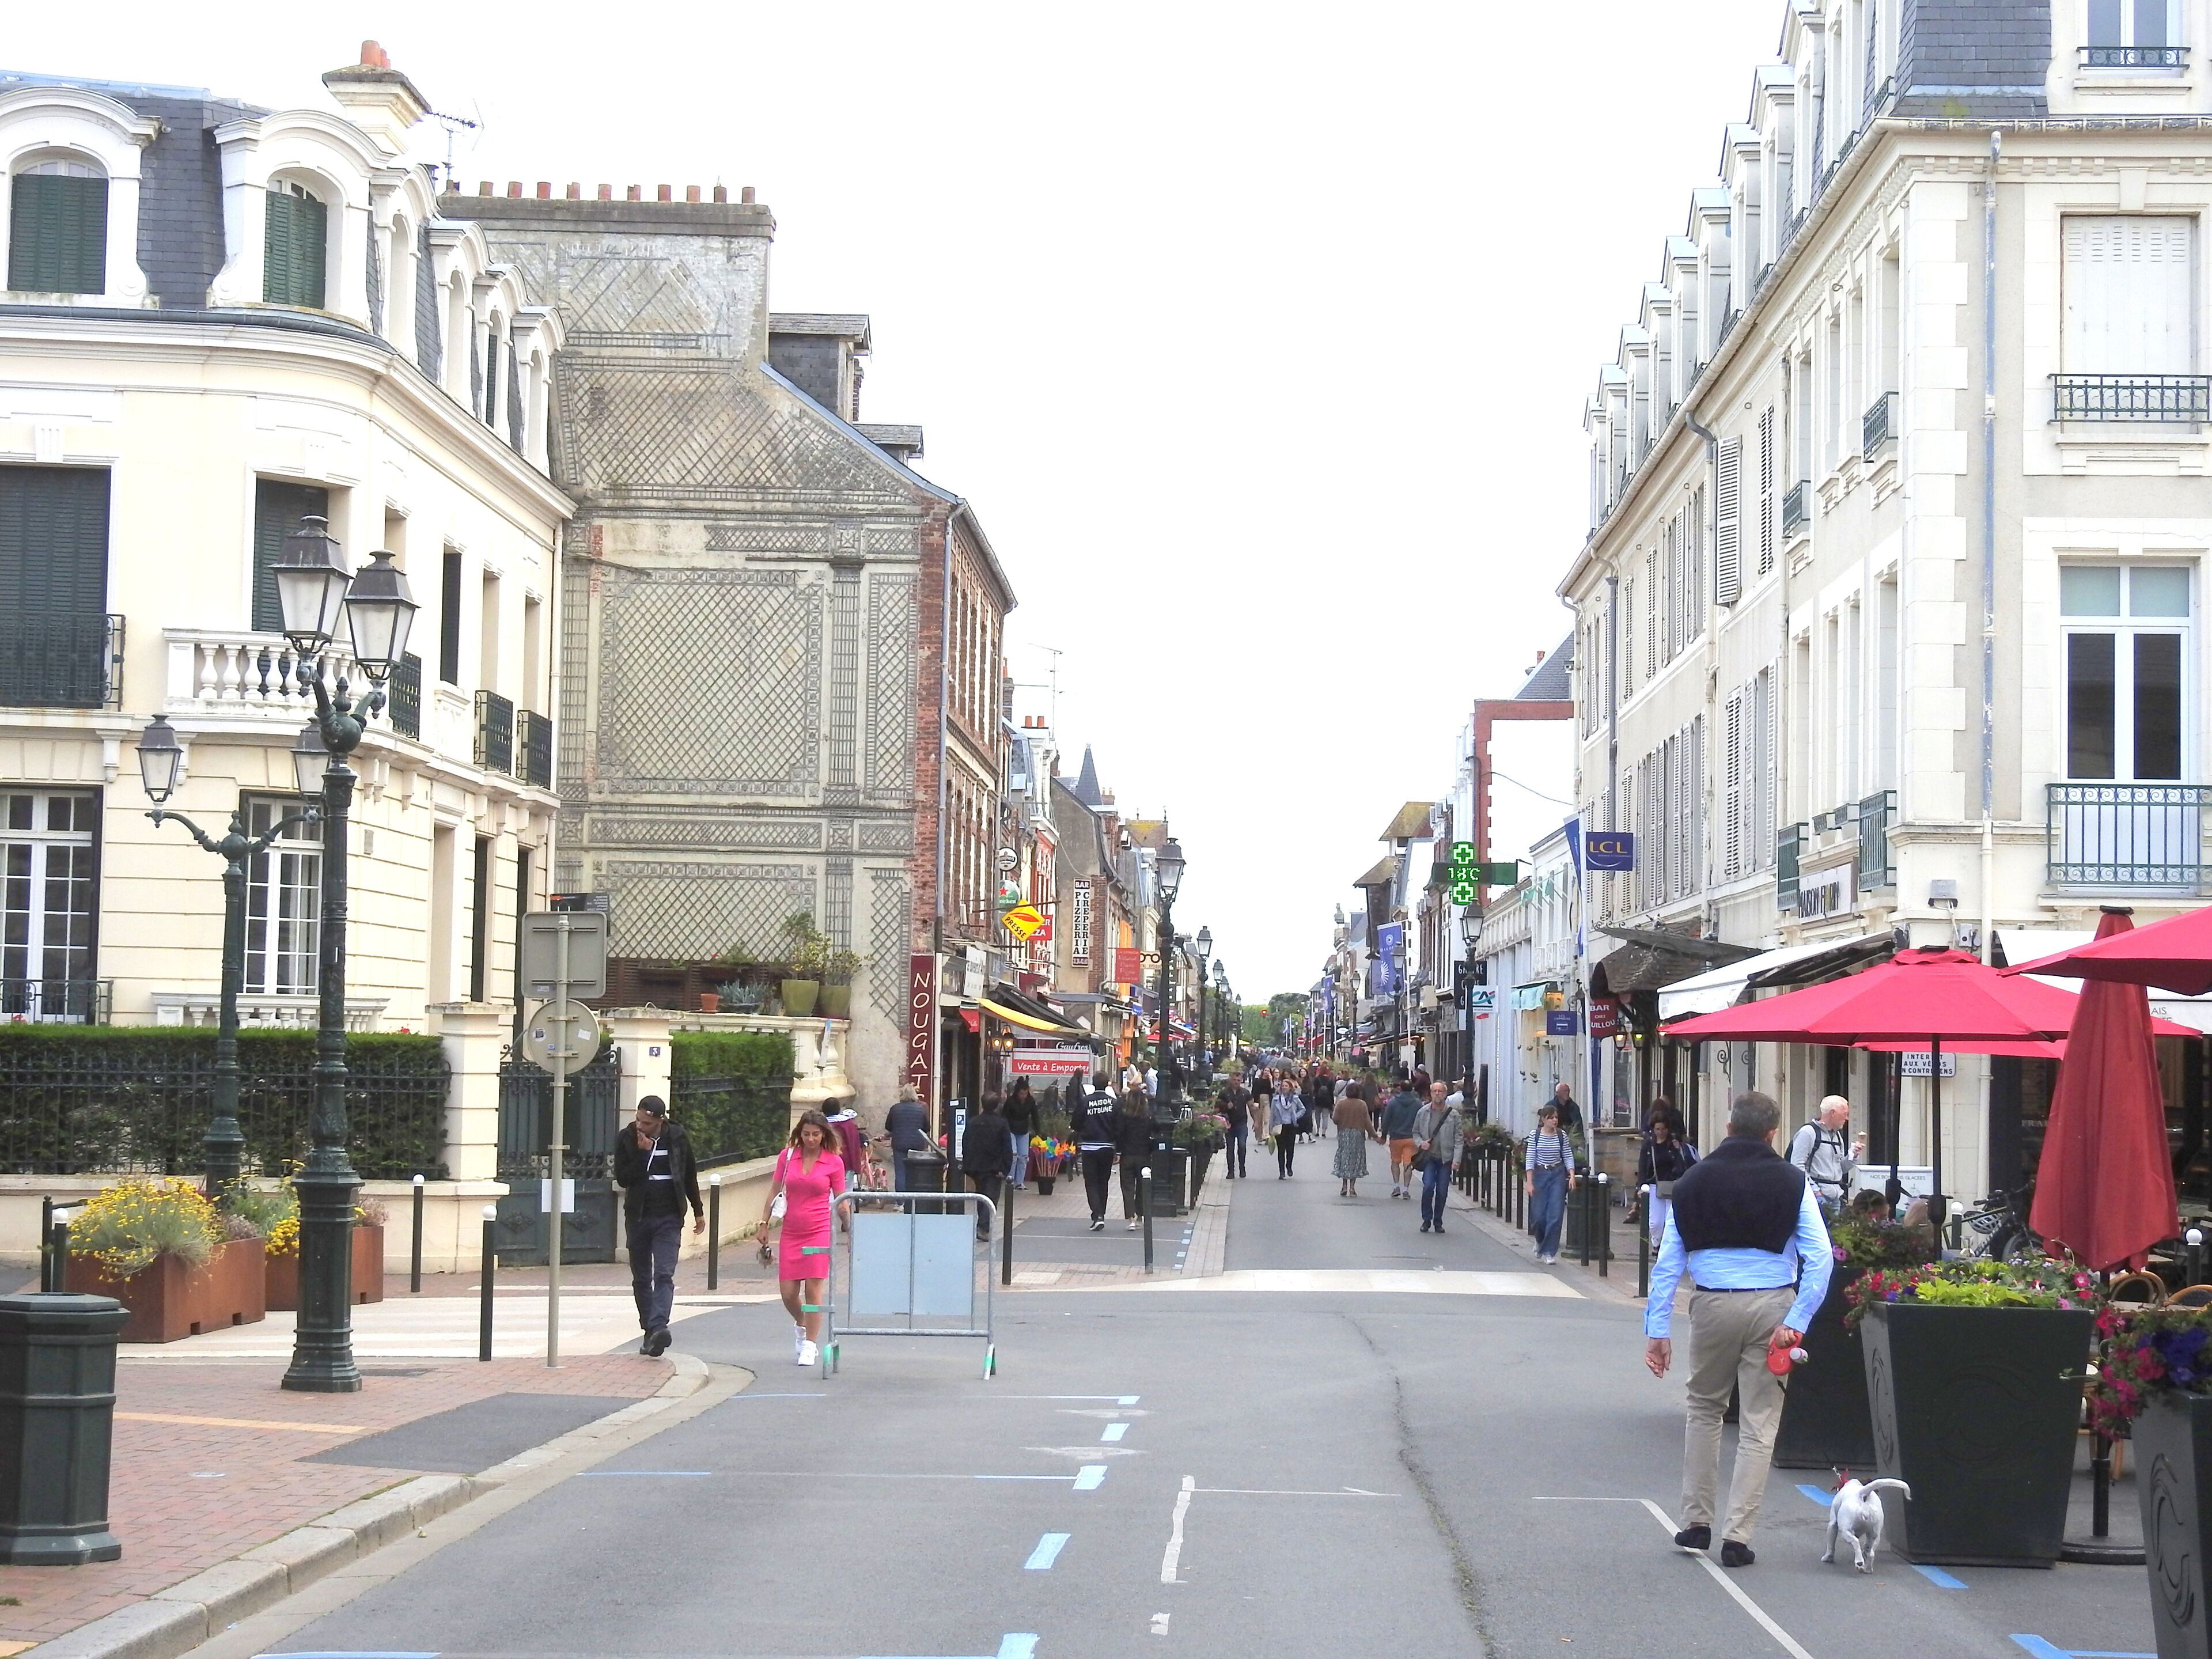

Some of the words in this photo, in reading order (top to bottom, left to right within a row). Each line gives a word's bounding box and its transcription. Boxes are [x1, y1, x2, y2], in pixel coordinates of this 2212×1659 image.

[1590, 841, 1627, 854] LCL
[1005, 916, 1027, 938] PRESSE
[1073, 892, 1081, 955] PIZZERIA
[1082, 892, 1090, 955] CREPERIE
[1590, 1019, 1615, 1028] UILLOU
[910, 972, 930, 1099] NOUGAT
[1056, 1041, 1089, 1050] Gaufres
[1017, 1062, 1041, 1071] Vente
[1043, 1062, 1048, 1071] à
[1088, 1098, 1112, 1107] MAISON
